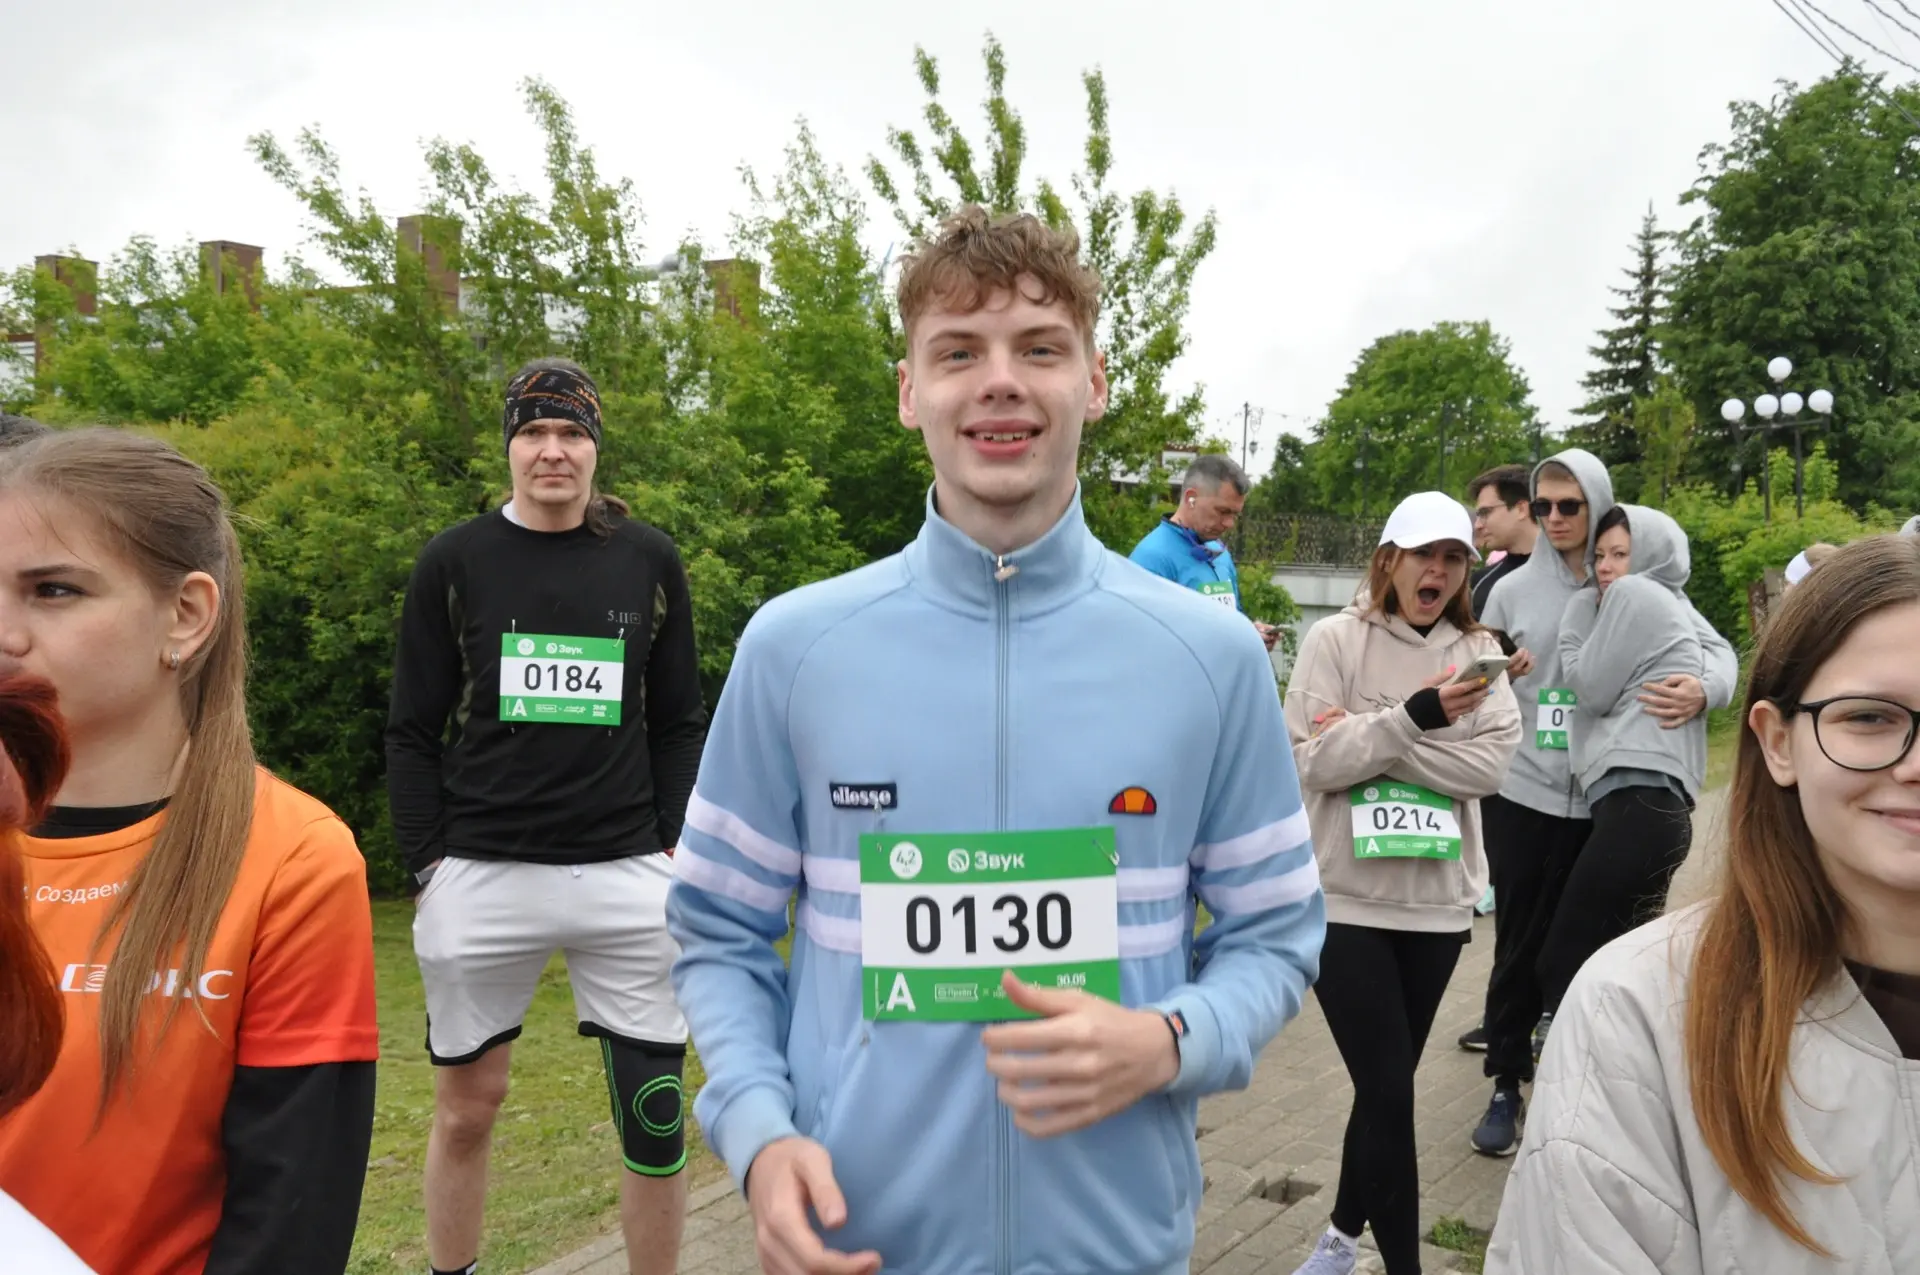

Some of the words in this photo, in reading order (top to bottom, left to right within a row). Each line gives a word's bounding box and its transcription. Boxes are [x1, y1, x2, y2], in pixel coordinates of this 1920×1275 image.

[558, 644, 584, 656] Звук
[524, 663, 603, 693] 0184
[511, 698, 528, 717] A
[1543, 732, 1554, 745] A
[1372, 806, 1441, 831] 0214
[1365, 838, 1380, 854] A
[974, 850, 1025, 873] Звук
[906, 892, 1072, 955] 0130
[886, 972, 916, 1012] A
